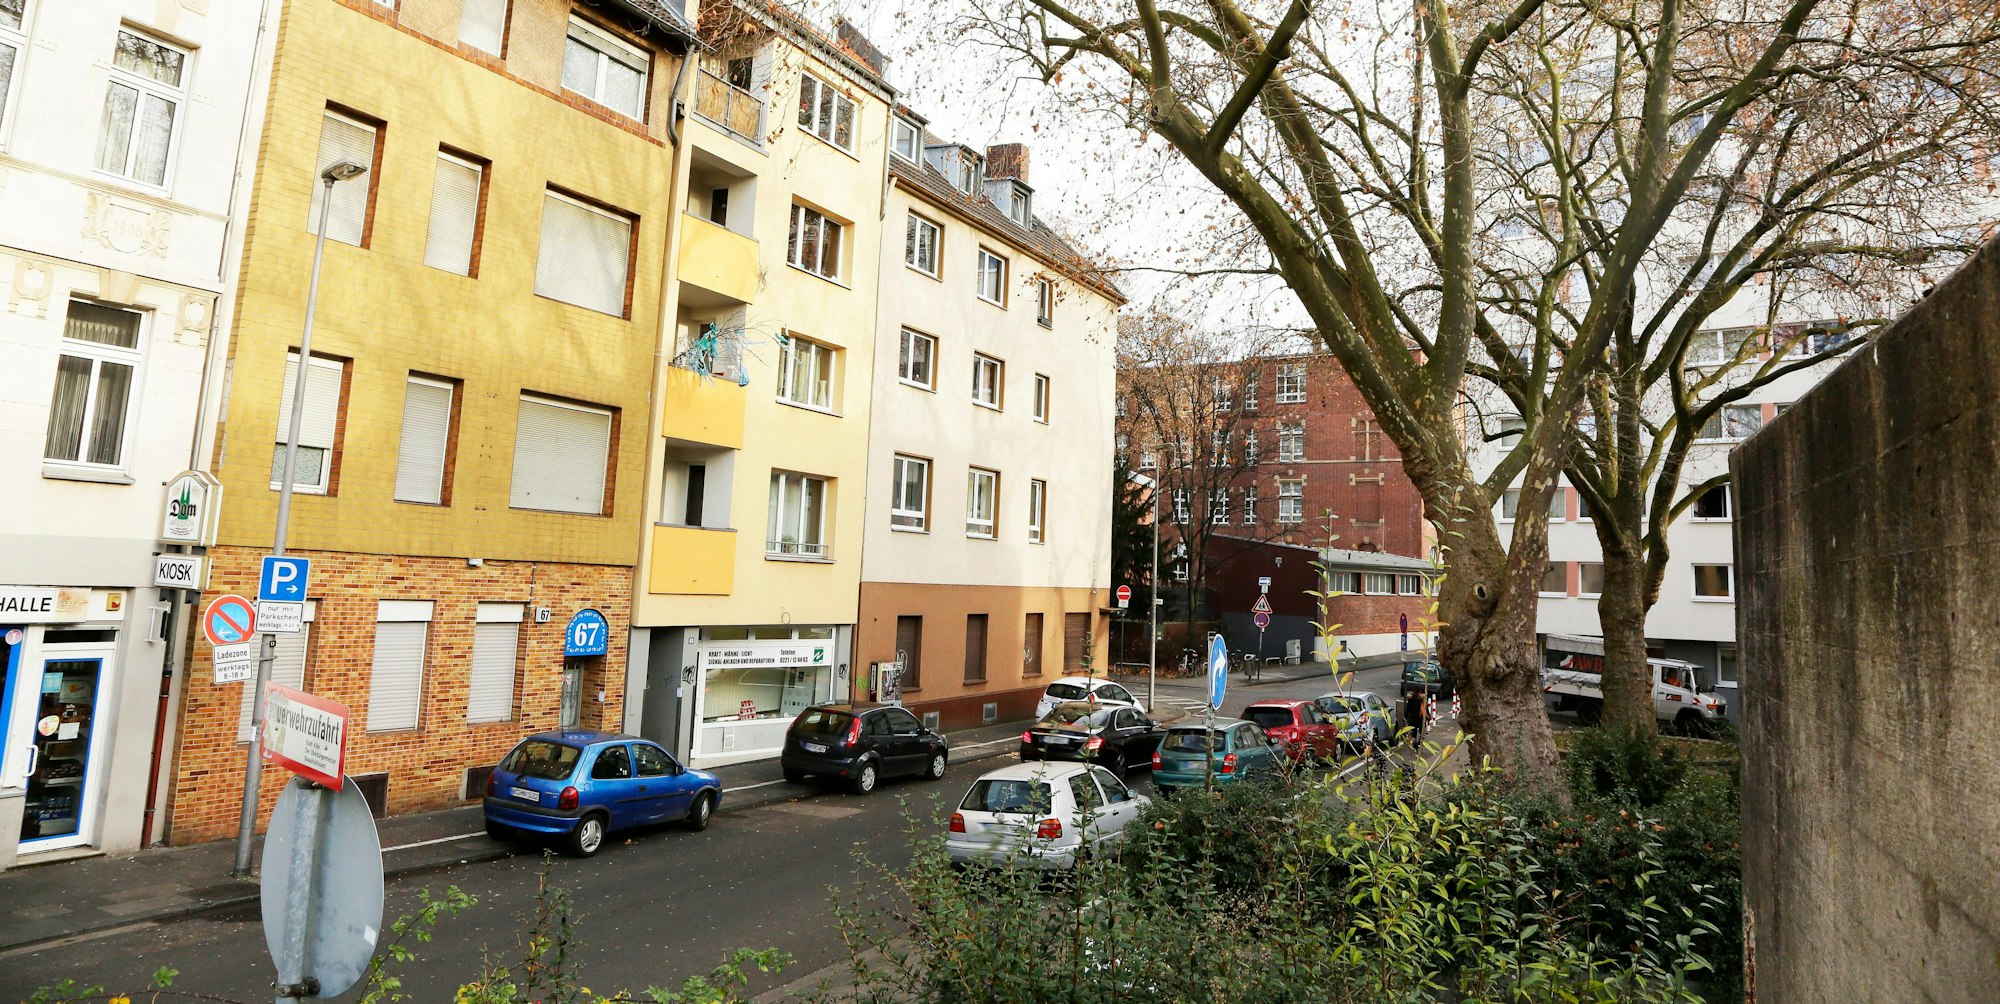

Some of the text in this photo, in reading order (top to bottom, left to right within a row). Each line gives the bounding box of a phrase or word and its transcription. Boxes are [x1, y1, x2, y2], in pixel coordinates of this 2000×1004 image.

[169, 499, 197, 517] Dom
[159, 562, 192, 581] KIOSK
[270, 561, 298, 595] P
[540, 609, 550, 621] 67
[574, 622, 600, 647] 67
[217, 649, 248, 660] Ladezone
[217, 663, 250, 673] werktags
[1573, 655, 1604, 673] AWB
[269, 702, 340, 746] uerwehrzufahrt
